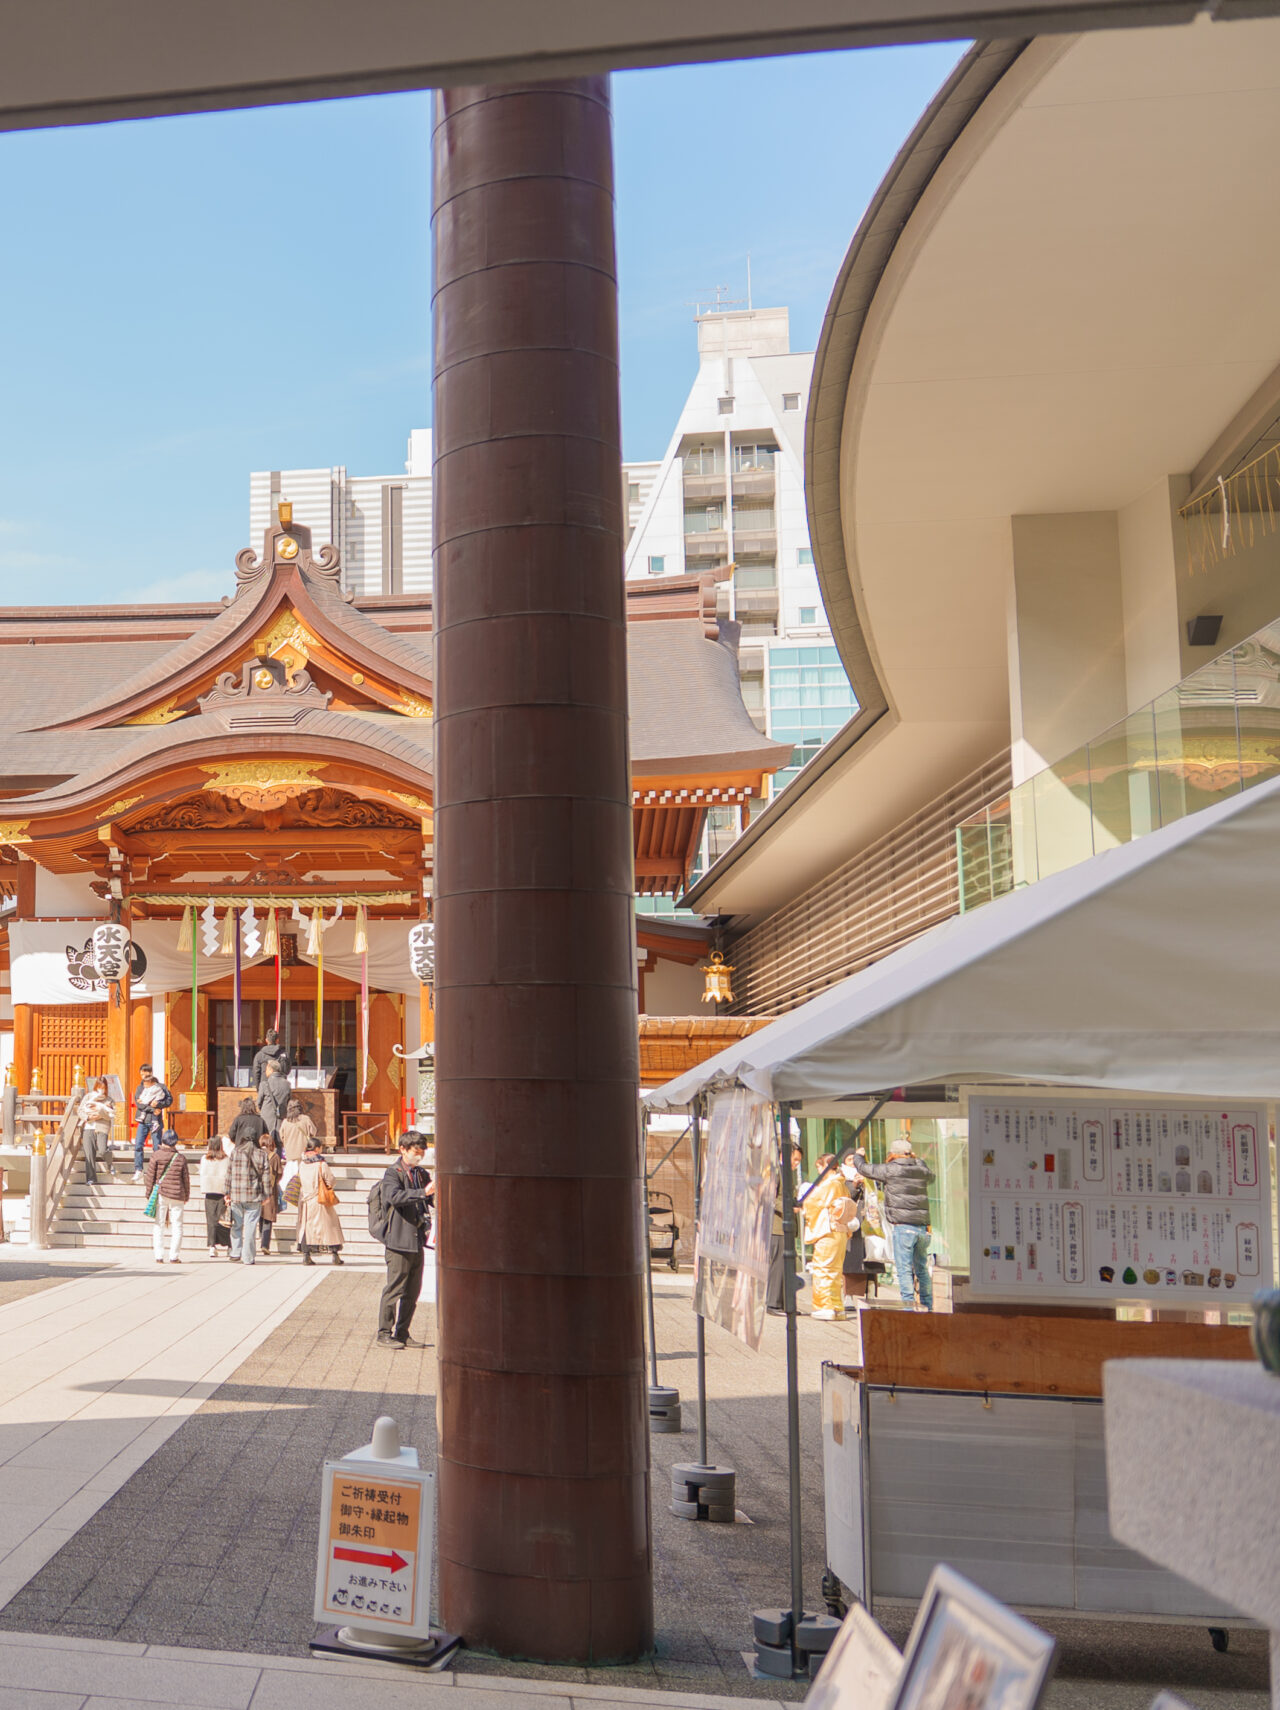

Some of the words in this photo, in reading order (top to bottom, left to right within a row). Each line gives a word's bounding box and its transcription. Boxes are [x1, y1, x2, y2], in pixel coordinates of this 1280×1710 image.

[97, 926, 122, 977] 水天宮
[413, 926, 434, 980] 水天宮
[340, 1504, 409, 1526] 御守・縁起物
[339, 1522, 375, 1539] 御朱印
[349, 1574, 407, 1592] お進み下さい
